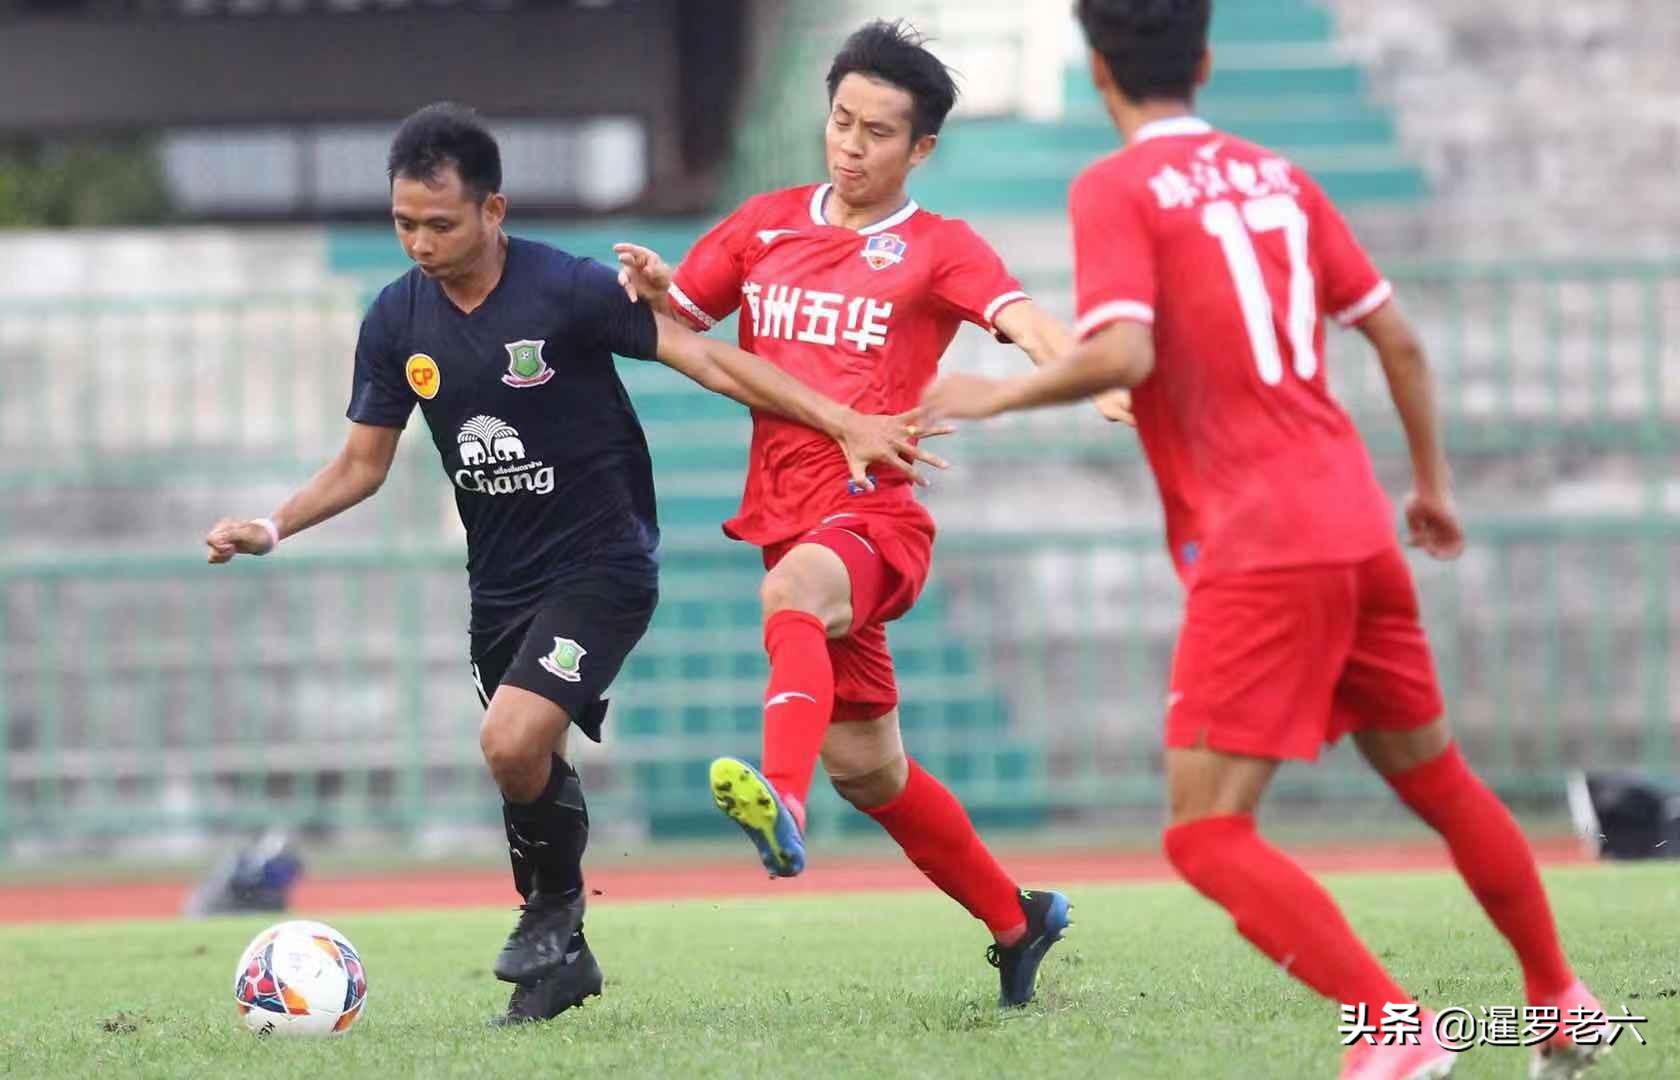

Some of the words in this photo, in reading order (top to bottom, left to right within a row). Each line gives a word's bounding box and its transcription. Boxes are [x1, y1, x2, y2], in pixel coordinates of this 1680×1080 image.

[1202, 194, 1318, 386] 17
[411, 367, 433, 386] CP
[455, 466, 555, 496] Chang
